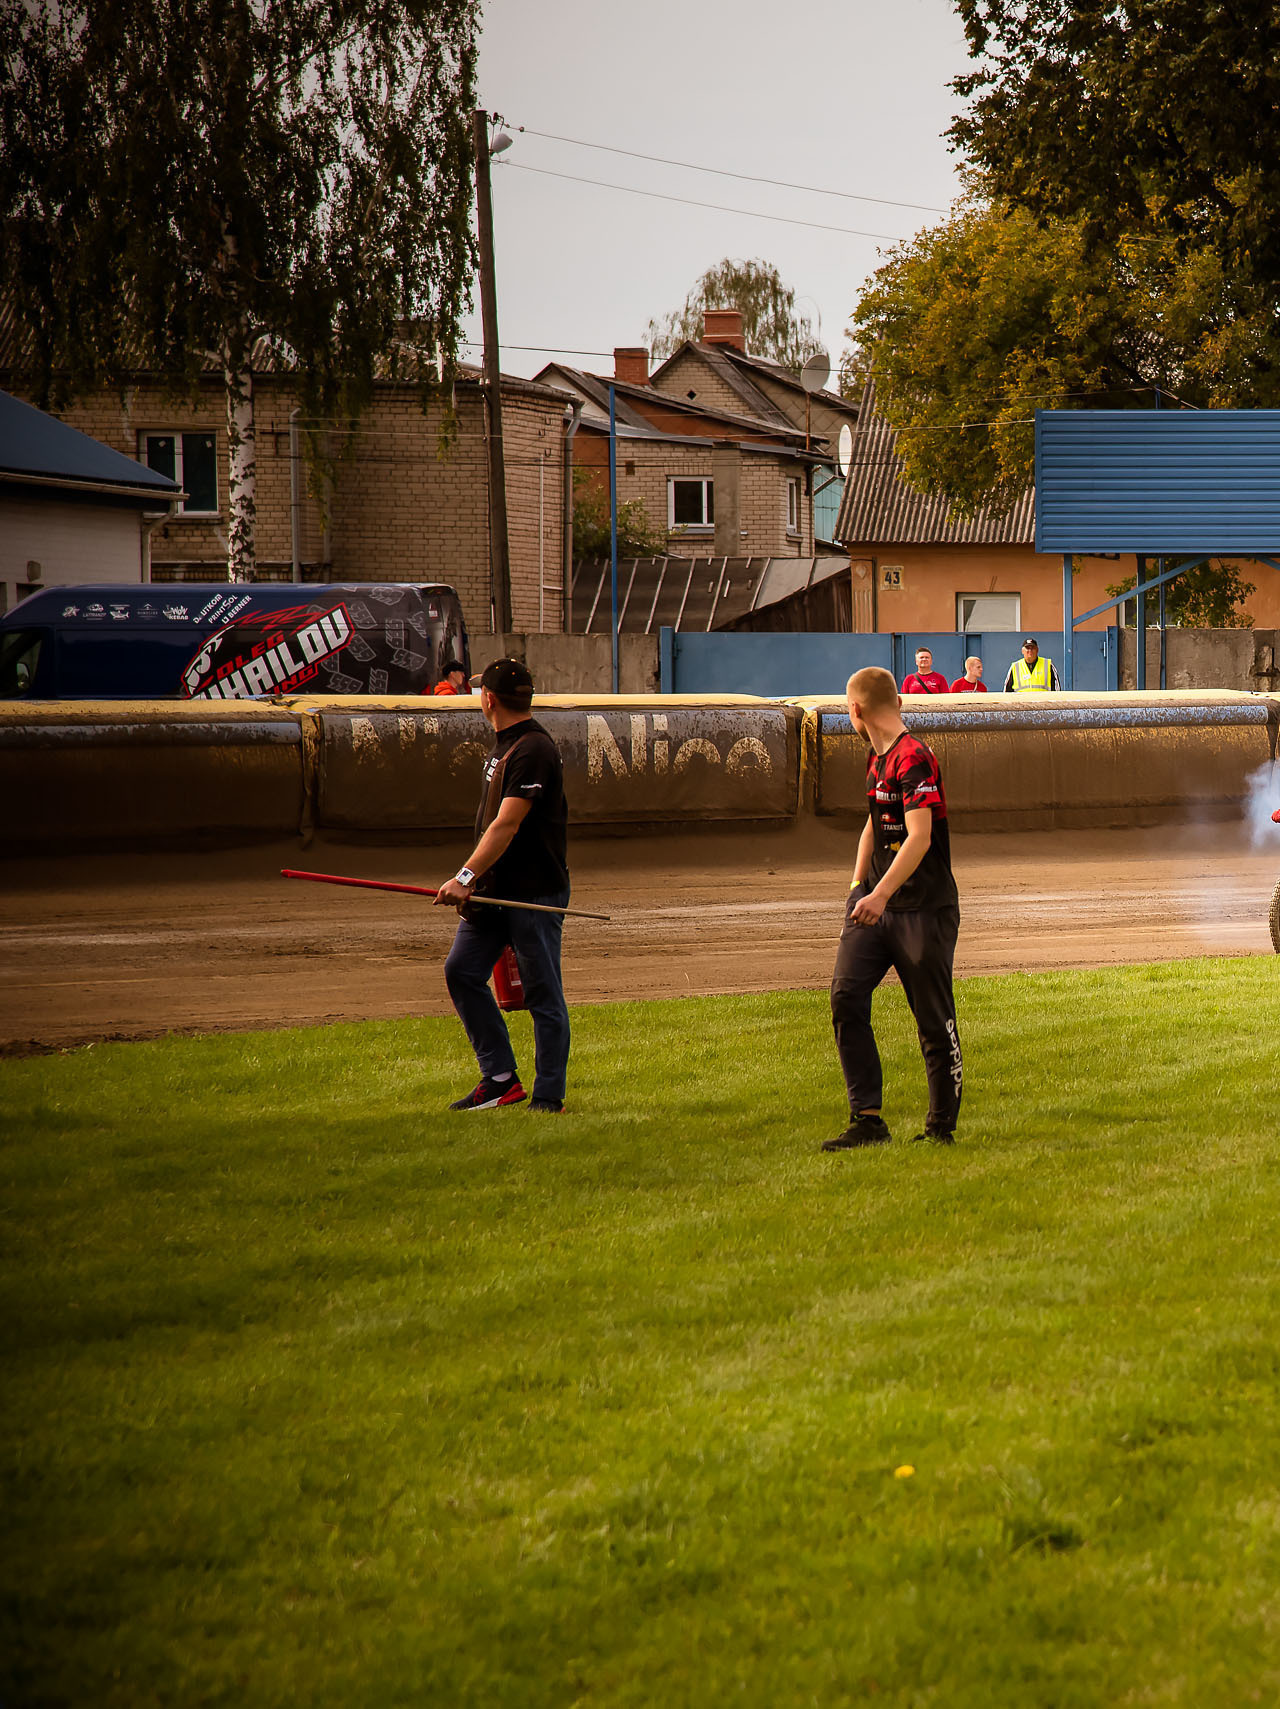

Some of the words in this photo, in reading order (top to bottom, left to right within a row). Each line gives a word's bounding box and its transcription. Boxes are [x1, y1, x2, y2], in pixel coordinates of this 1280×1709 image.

[884, 571, 900, 584] 43
[193, 594, 223, 624] DUTKOM
[216, 630, 285, 680] OLEG
